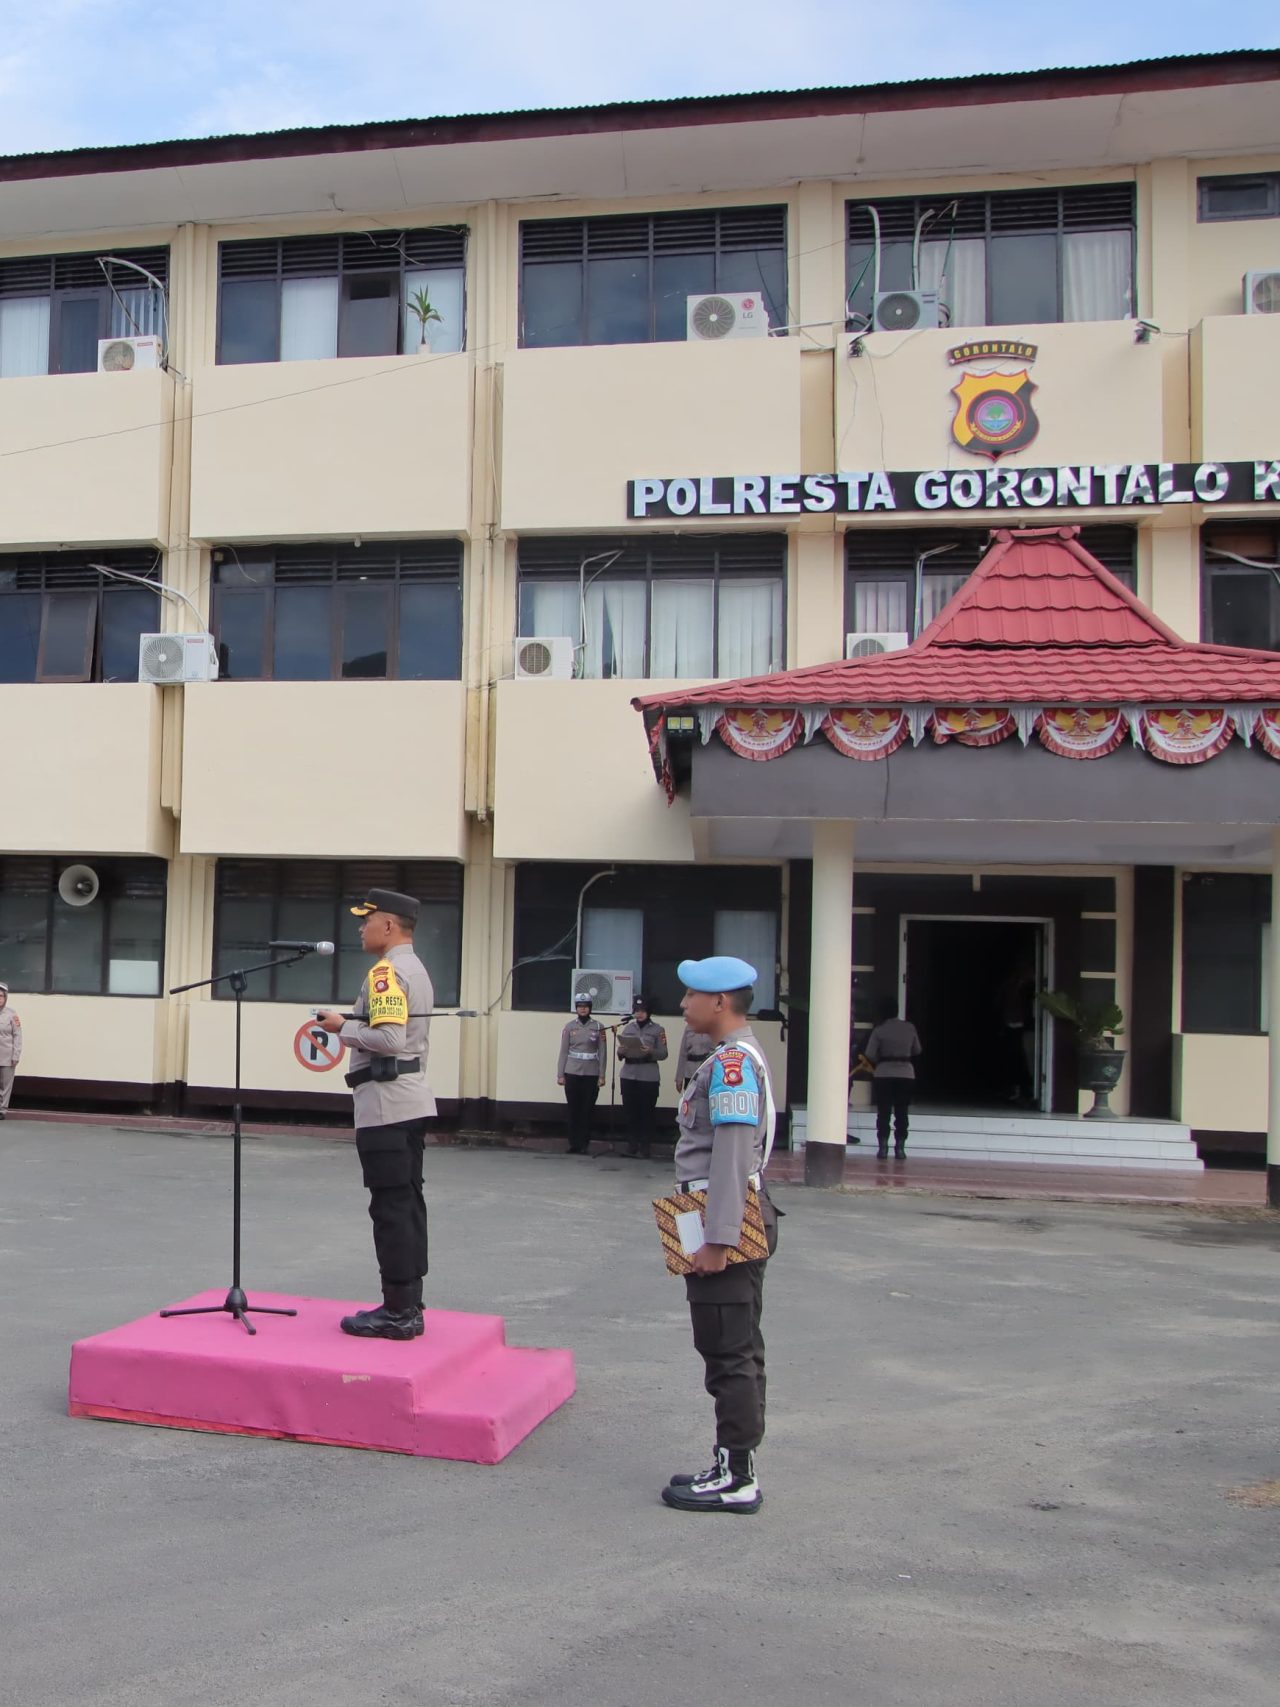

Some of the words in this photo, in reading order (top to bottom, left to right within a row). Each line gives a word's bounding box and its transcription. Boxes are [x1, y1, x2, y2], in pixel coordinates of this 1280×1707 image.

[742, 311, 754, 319] LG
[953, 343, 1033, 360] GORONTALO
[633, 471, 897, 517] POLRESTA
[914, 462, 1230, 510] GORONTALO
[310, 1031, 329, 1061] P
[708, 1090, 759, 1120] PROV
